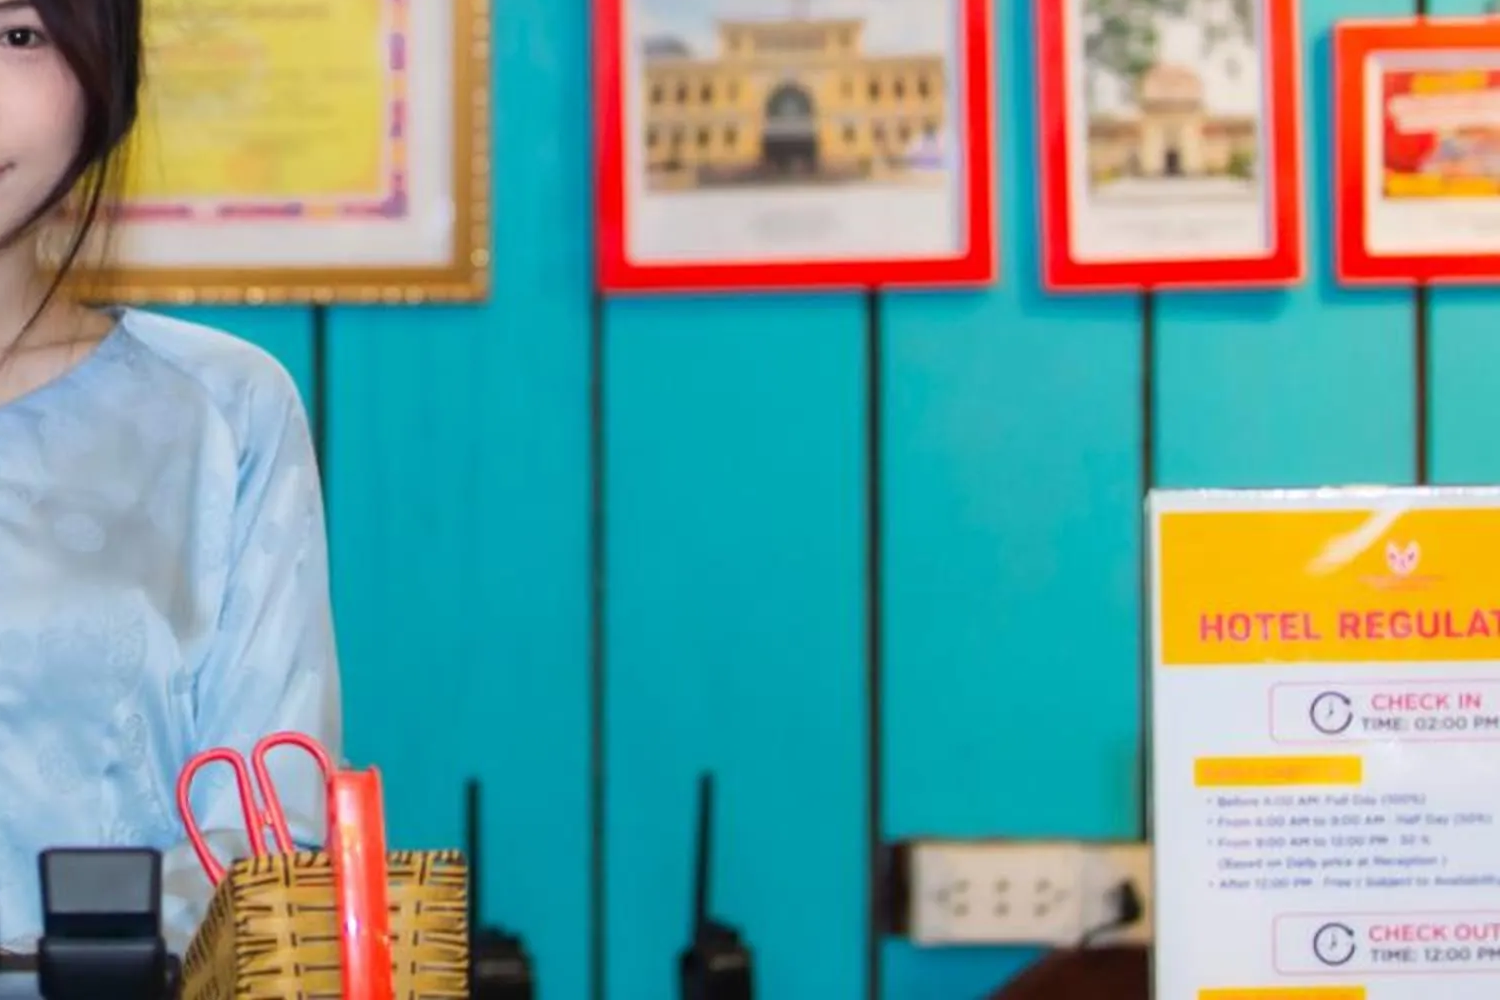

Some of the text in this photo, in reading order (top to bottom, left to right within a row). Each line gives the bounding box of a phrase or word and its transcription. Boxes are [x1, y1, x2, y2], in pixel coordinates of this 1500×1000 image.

[1199, 611, 1321, 642] HOTEL
[1371, 693, 1482, 711] CHECK IN
[1414, 715, 1468, 731] 02:00
[1473, 715, 1500, 730] PM
[1369, 922, 1500, 942] CHECK OUT
[1370, 946, 1418, 963] TIME:
[1424, 945, 1471, 962] 12:00
